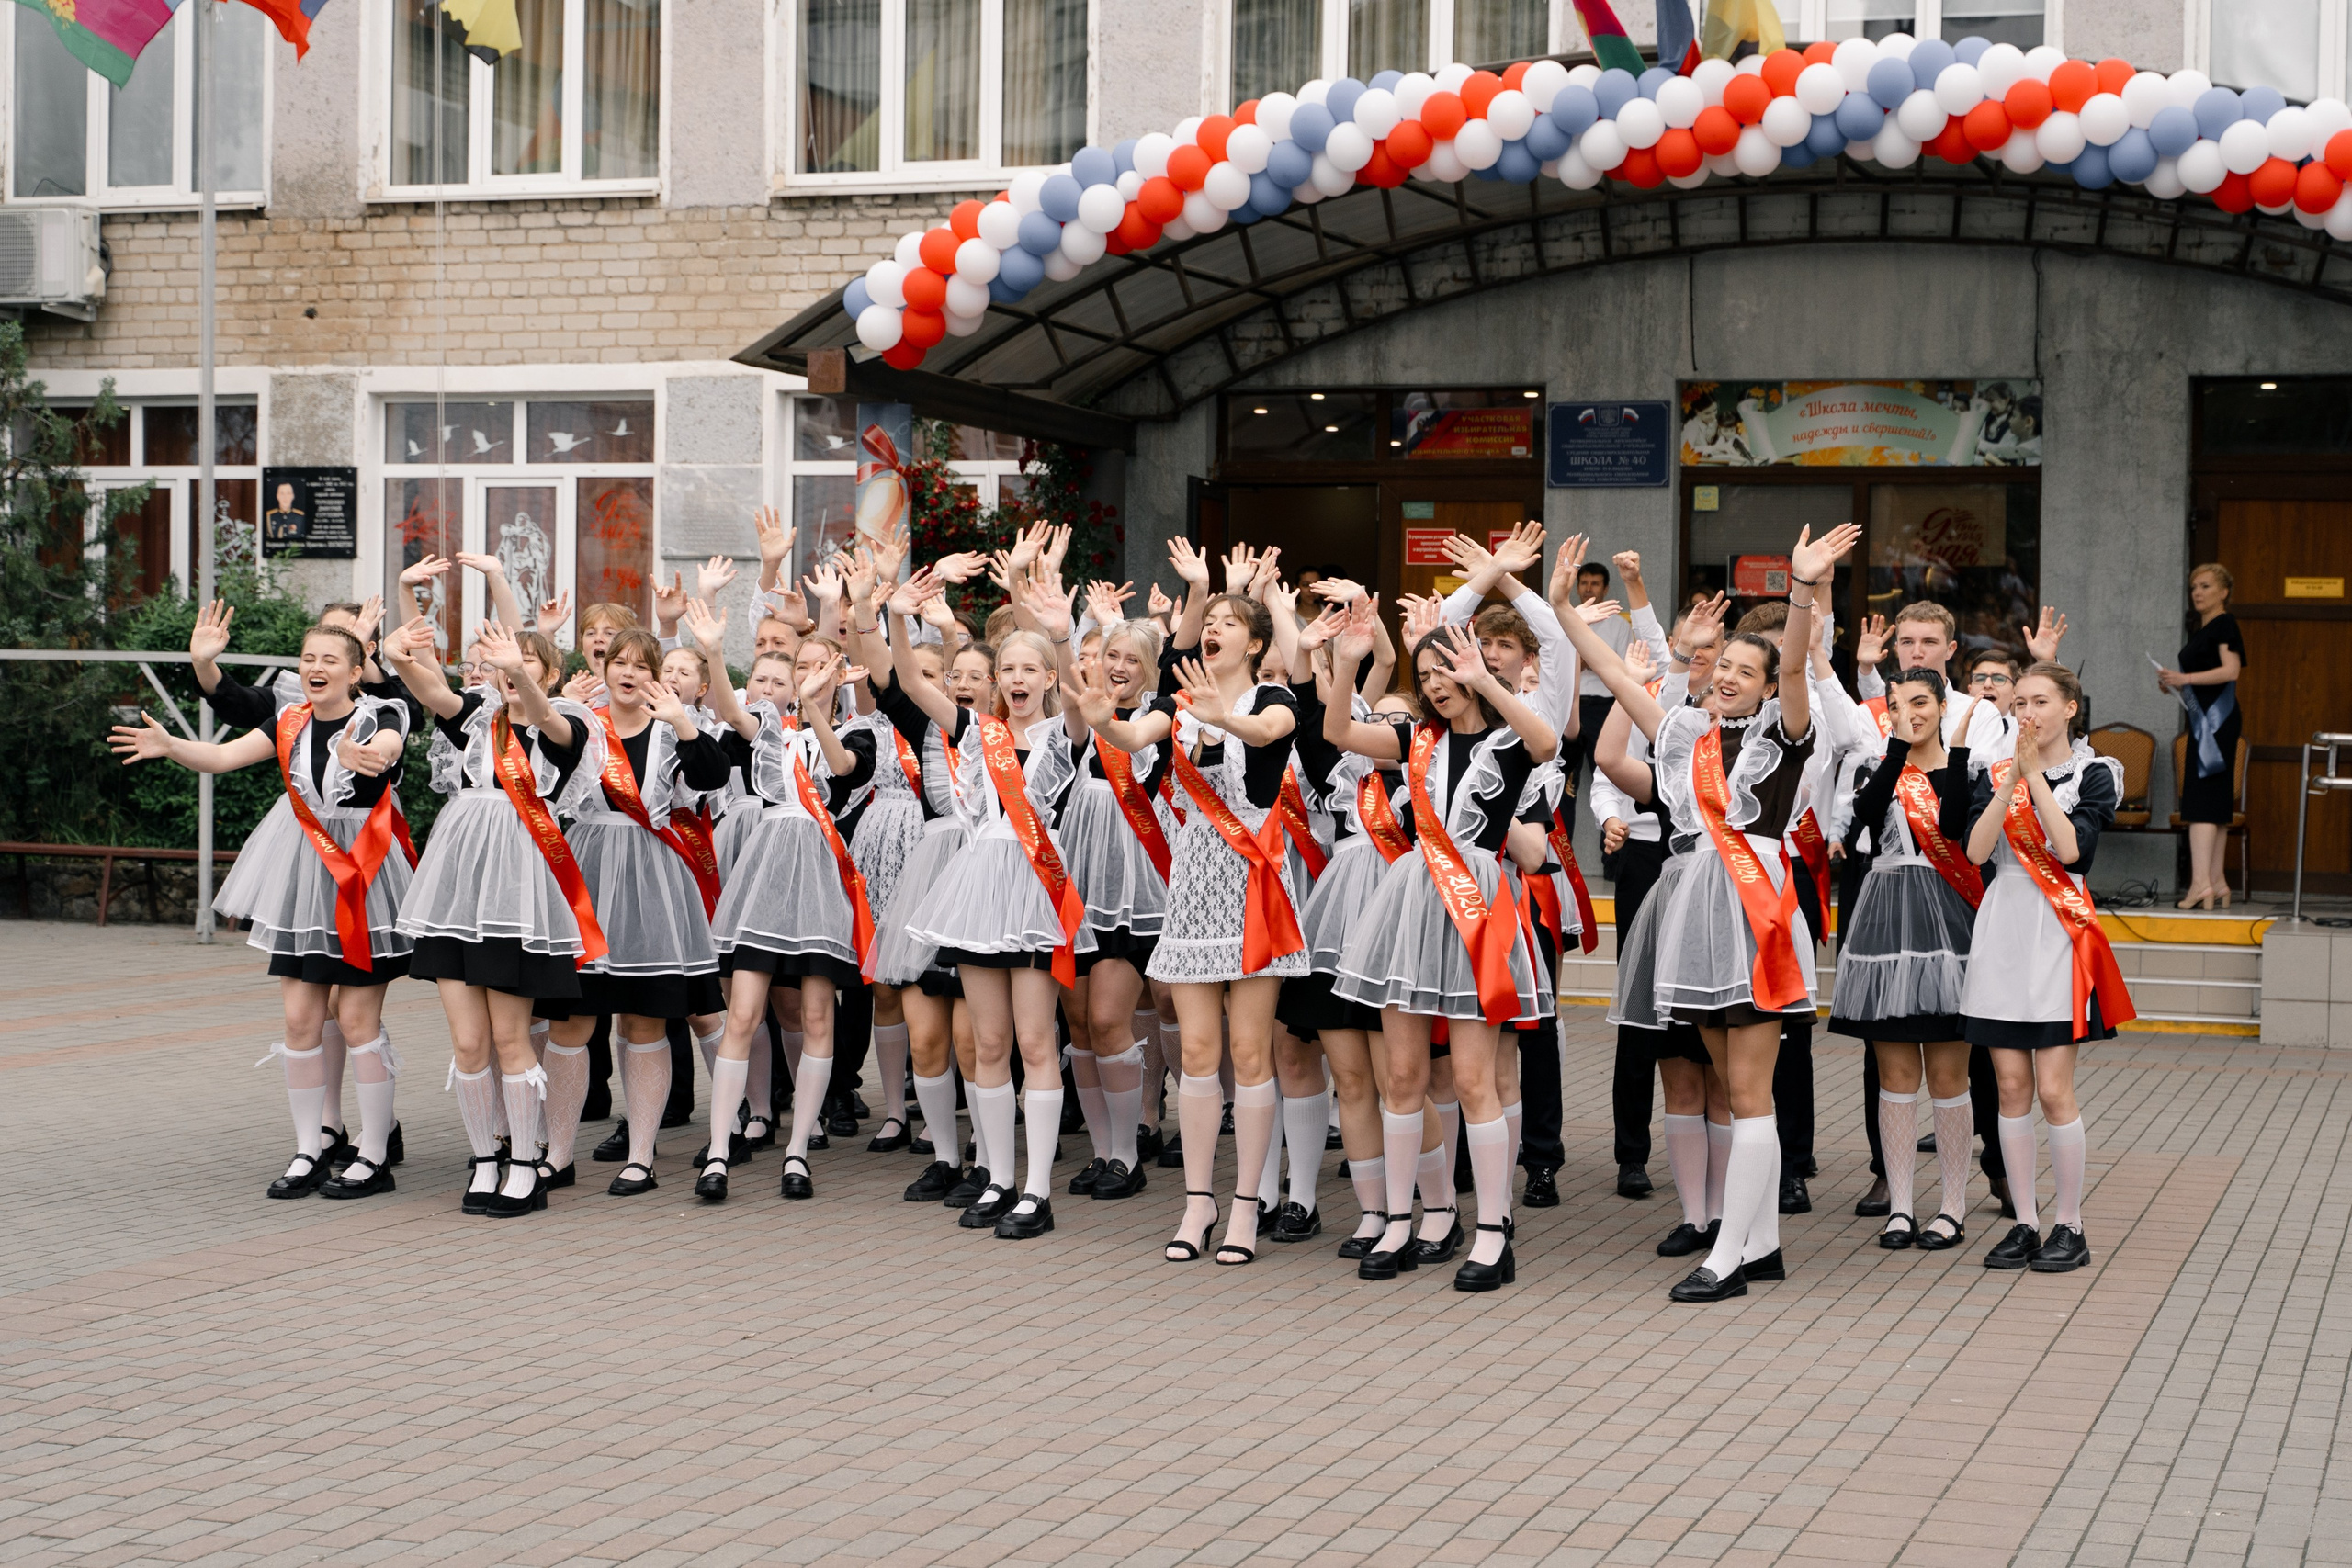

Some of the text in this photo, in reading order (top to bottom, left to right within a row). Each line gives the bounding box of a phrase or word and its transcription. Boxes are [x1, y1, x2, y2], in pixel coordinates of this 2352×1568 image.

[1798, 400, 1918, 420] «Школа мечты,
[1453, 425, 1527, 434] ИЗБИРАТЕЛЬНАЯ
[1792, 424, 1849, 444] надежды
[1851, 424, 1860, 434] и
[1569, 456, 1647, 465] ШКОЛА № 40
[995, 747, 1045, 847] Выпускница
[1130, 807, 1157, 835] 2026
[1385, 811, 1407, 847] Виктория
[1901, 772, 1956, 873] Выпускница
[541, 834, 570, 864] 2026
[694, 847, 716, 874] 2026
[2007, 783, 2059, 885] Выпускница
[2058, 885, 2098, 930] 2026
[1729, 852, 1764, 885] 2026
[1447, 872, 1487, 920] 2026
